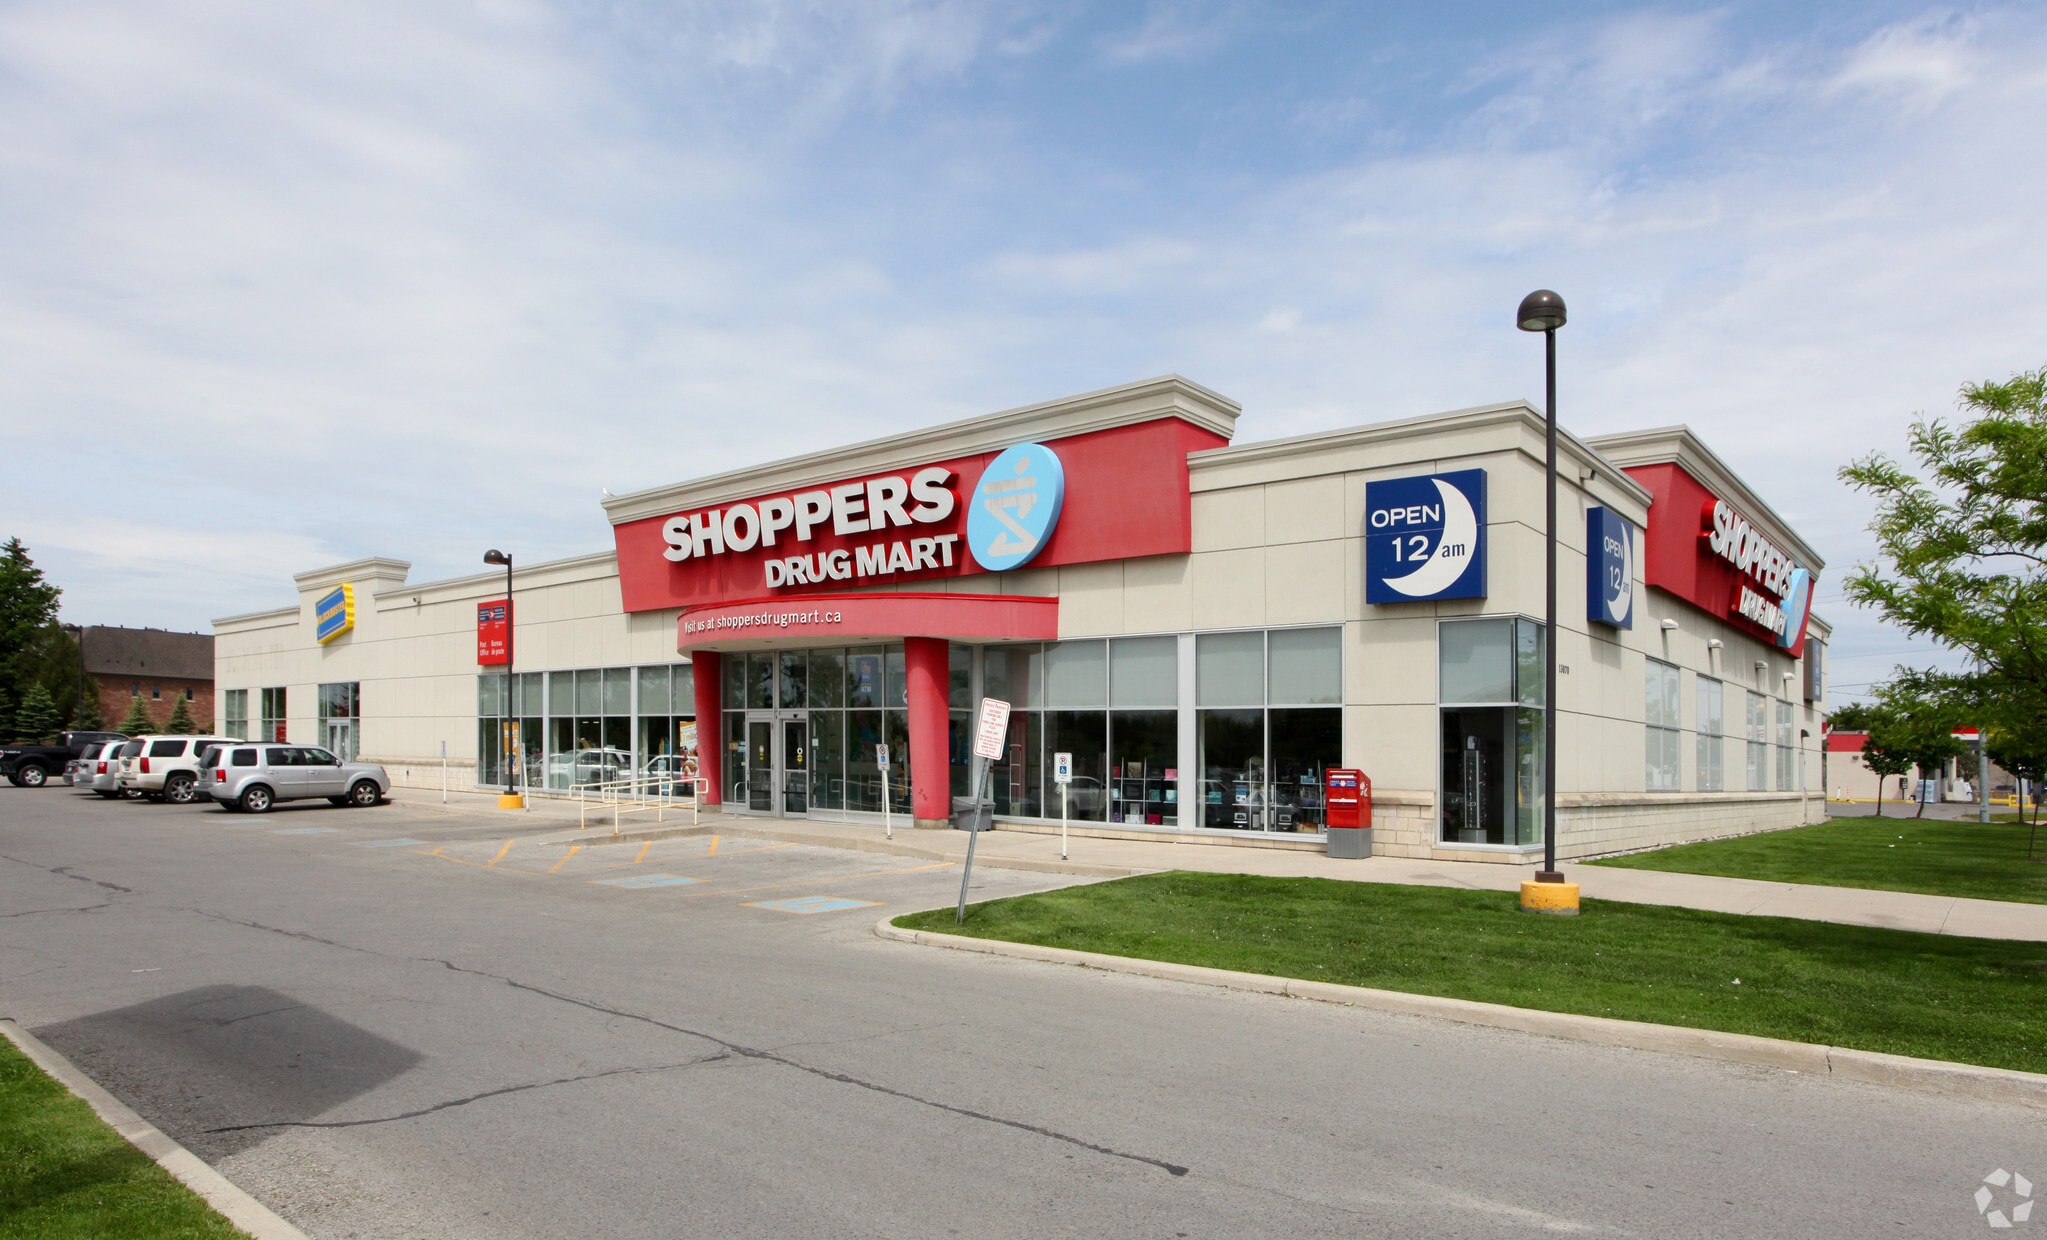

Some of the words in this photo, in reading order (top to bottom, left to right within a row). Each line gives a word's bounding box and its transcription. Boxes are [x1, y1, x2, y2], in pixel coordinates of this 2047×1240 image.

[662, 467, 956, 562] SHOPPERS
[1371, 503, 1440, 528] OPEN
[764, 549, 852, 588] DRUG
[855, 533, 959, 577] MART
[1391, 535, 1429, 562] 12
[1441, 543, 1465, 558] am
[1603, 535, 1624, 560] OPEN
[1709, 500, 1795, 601] SHOPPERS
[1609, 564, 1621, 590] 12
[685, 622, 696, 634] Visit
[698, 621, 705, 631] us
[707, 617, 715, 629] at
[717, 610, 842, 630] shoppersdrugmart.ca
[1738, 585, 1766, 625] DRUG
[1763, 601, 1788, 636] MART
